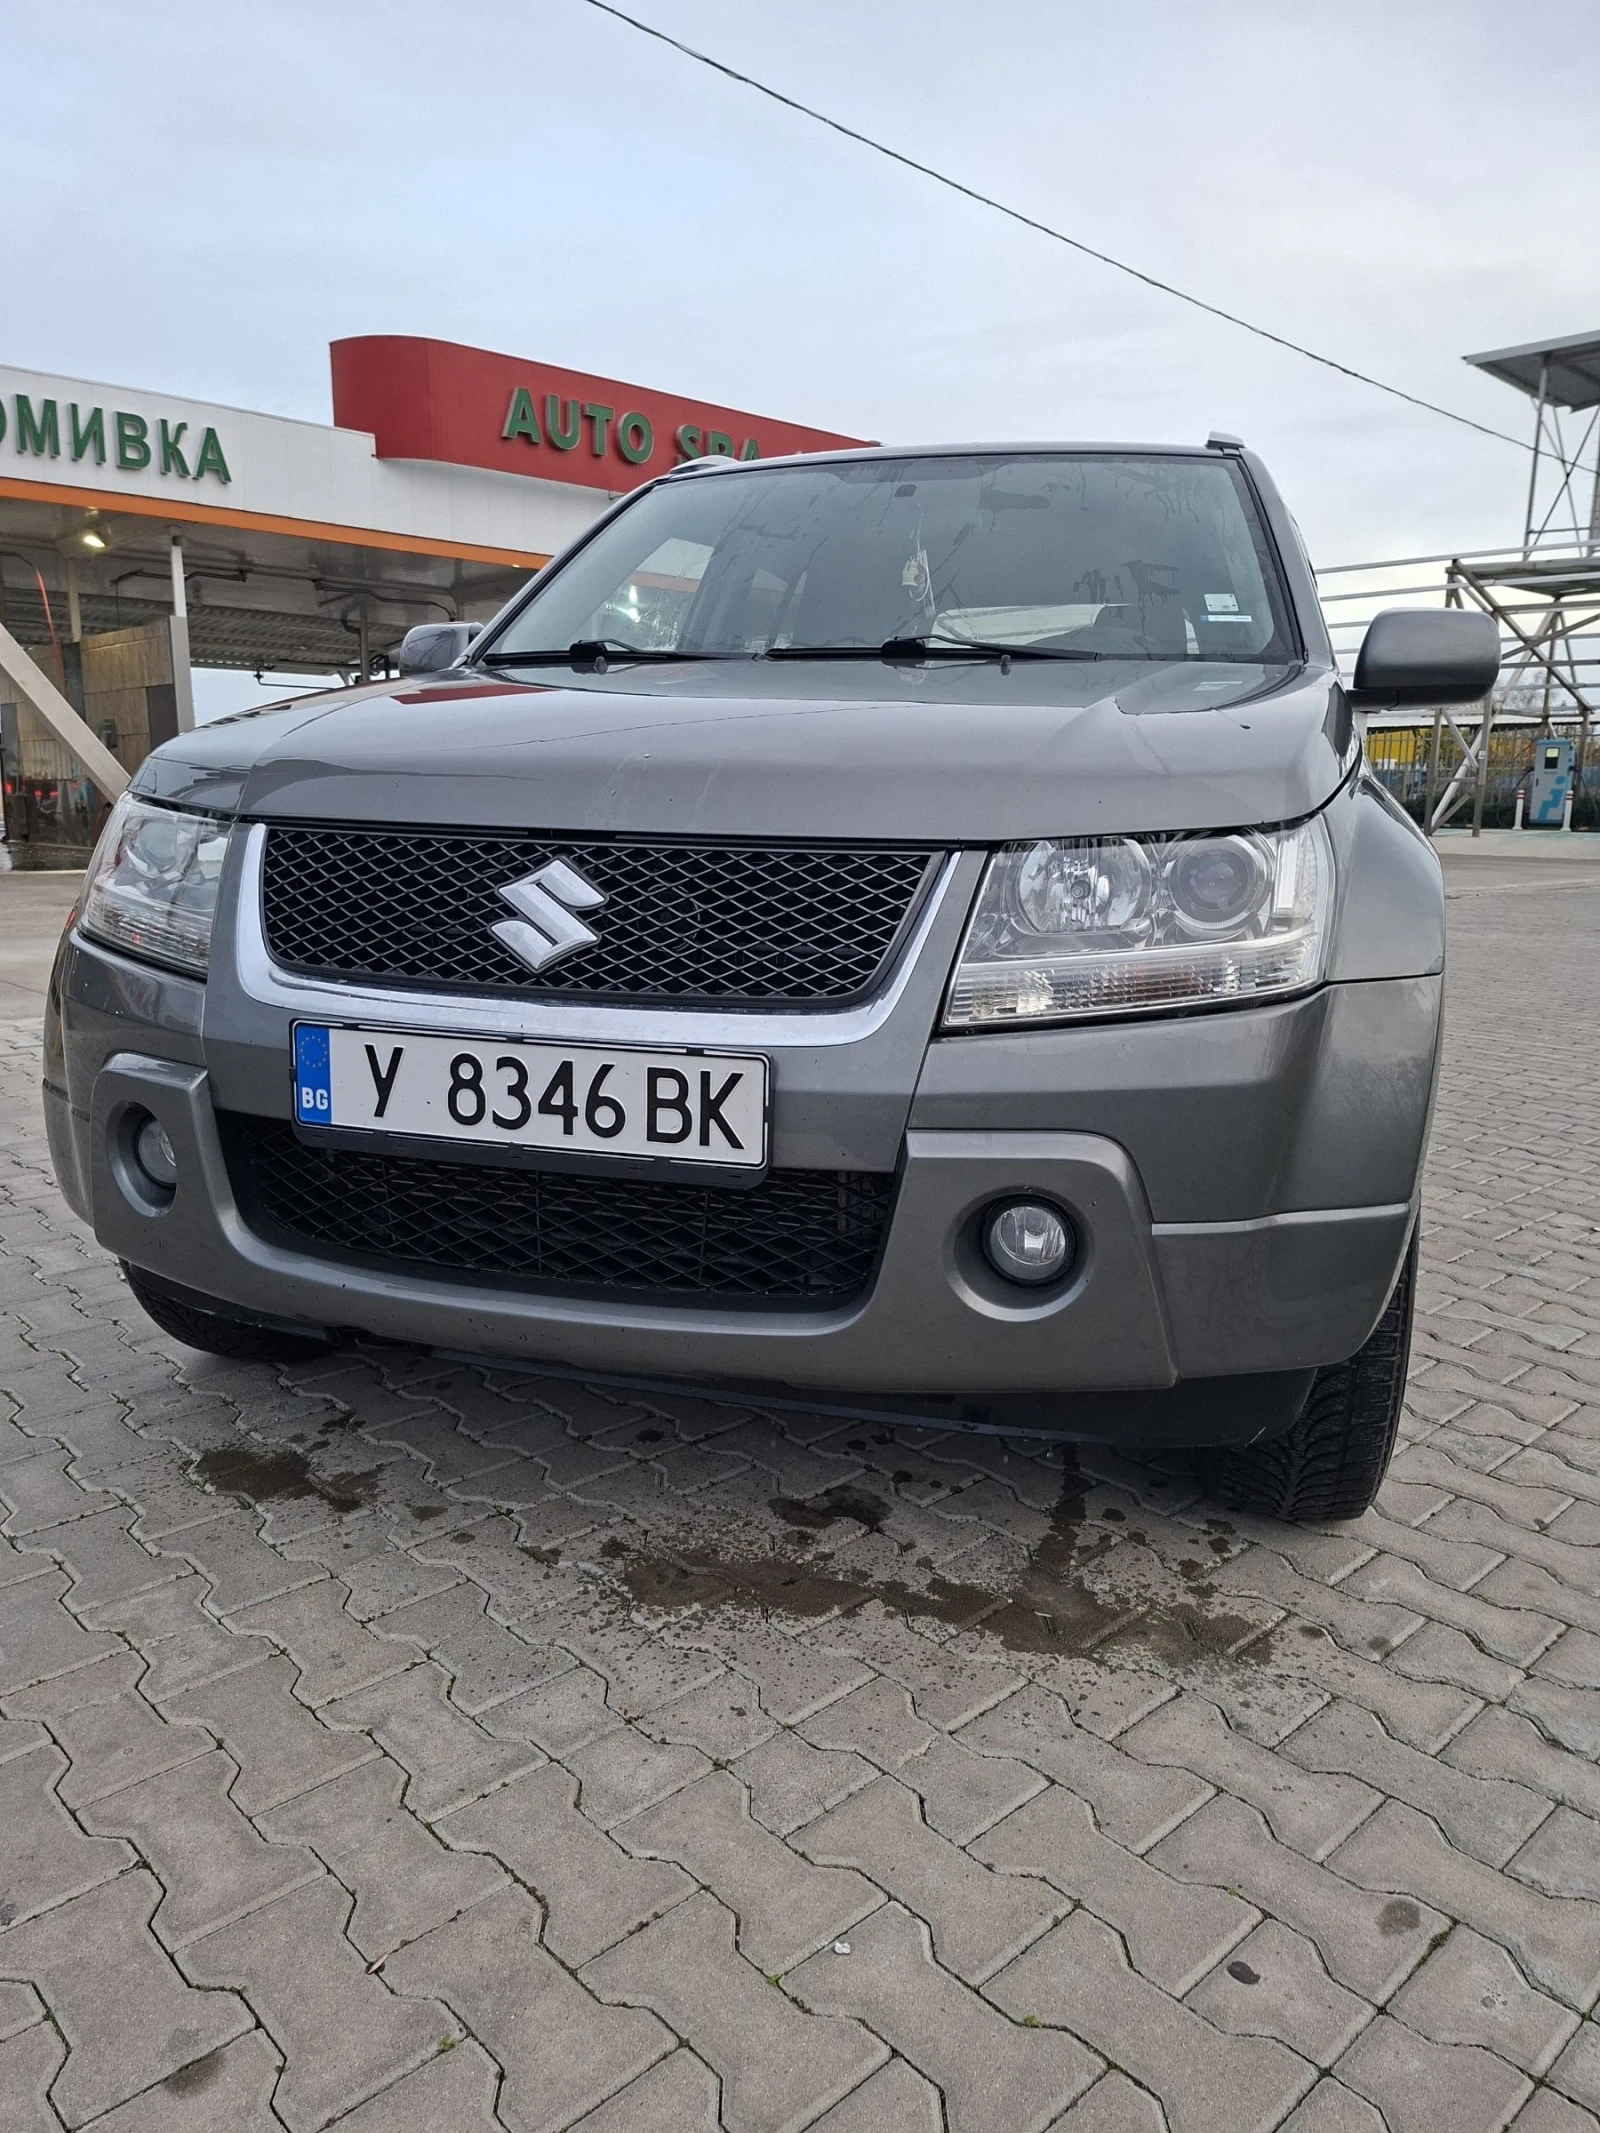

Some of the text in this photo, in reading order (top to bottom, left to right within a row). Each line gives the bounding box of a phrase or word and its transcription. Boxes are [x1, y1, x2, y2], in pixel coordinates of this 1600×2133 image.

[0, 393, 232, 484] МИВКА
[502, 387, 653, 464] AUTO
[301, 1086, 329, 1110] BG
[447, 1053, 627, 1139] 8346
